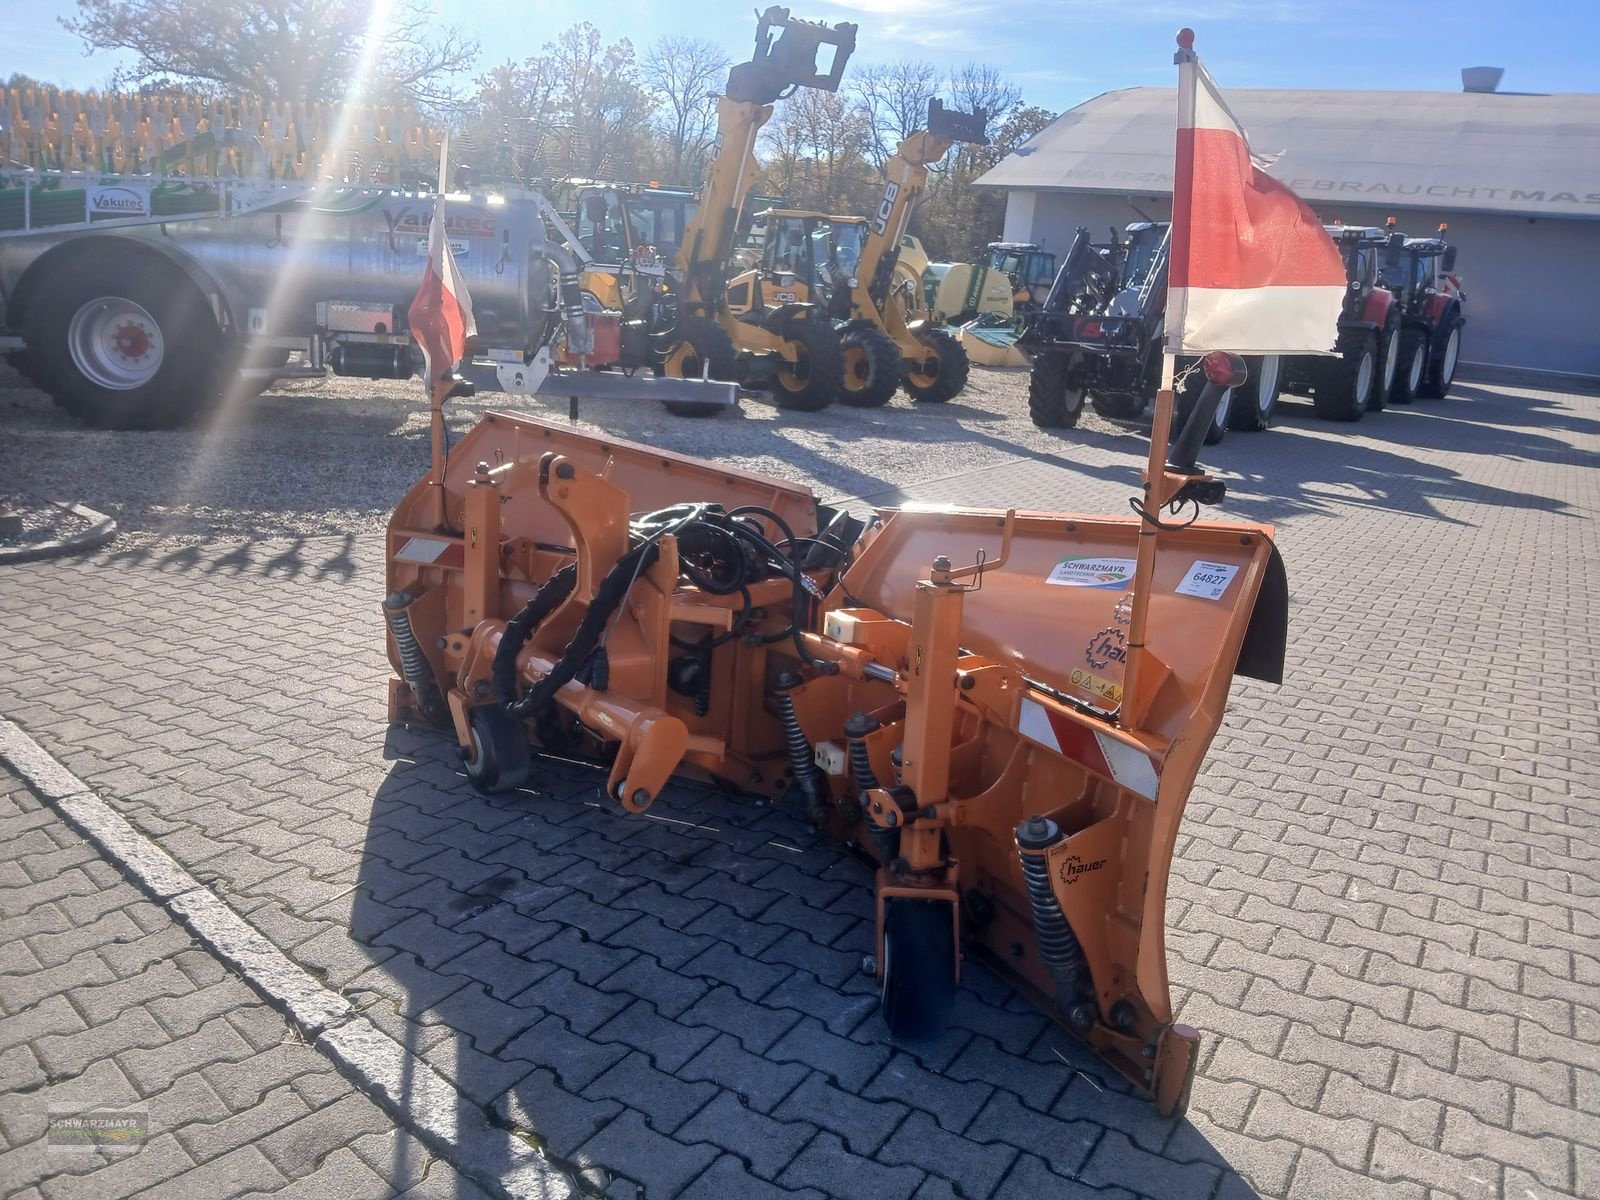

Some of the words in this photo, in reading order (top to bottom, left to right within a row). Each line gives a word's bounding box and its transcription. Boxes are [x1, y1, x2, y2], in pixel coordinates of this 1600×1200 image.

[92, 194, 144, 209] Vakutec
[876, 182, 899, 236] JCB
[772, 292, 796, 302] JCB
[1062, 562, 1126, 573] SCHWARZMAYR
[1192, 572, 1228, 585] 64827
[1067, 859, 1108, 876] hauer
